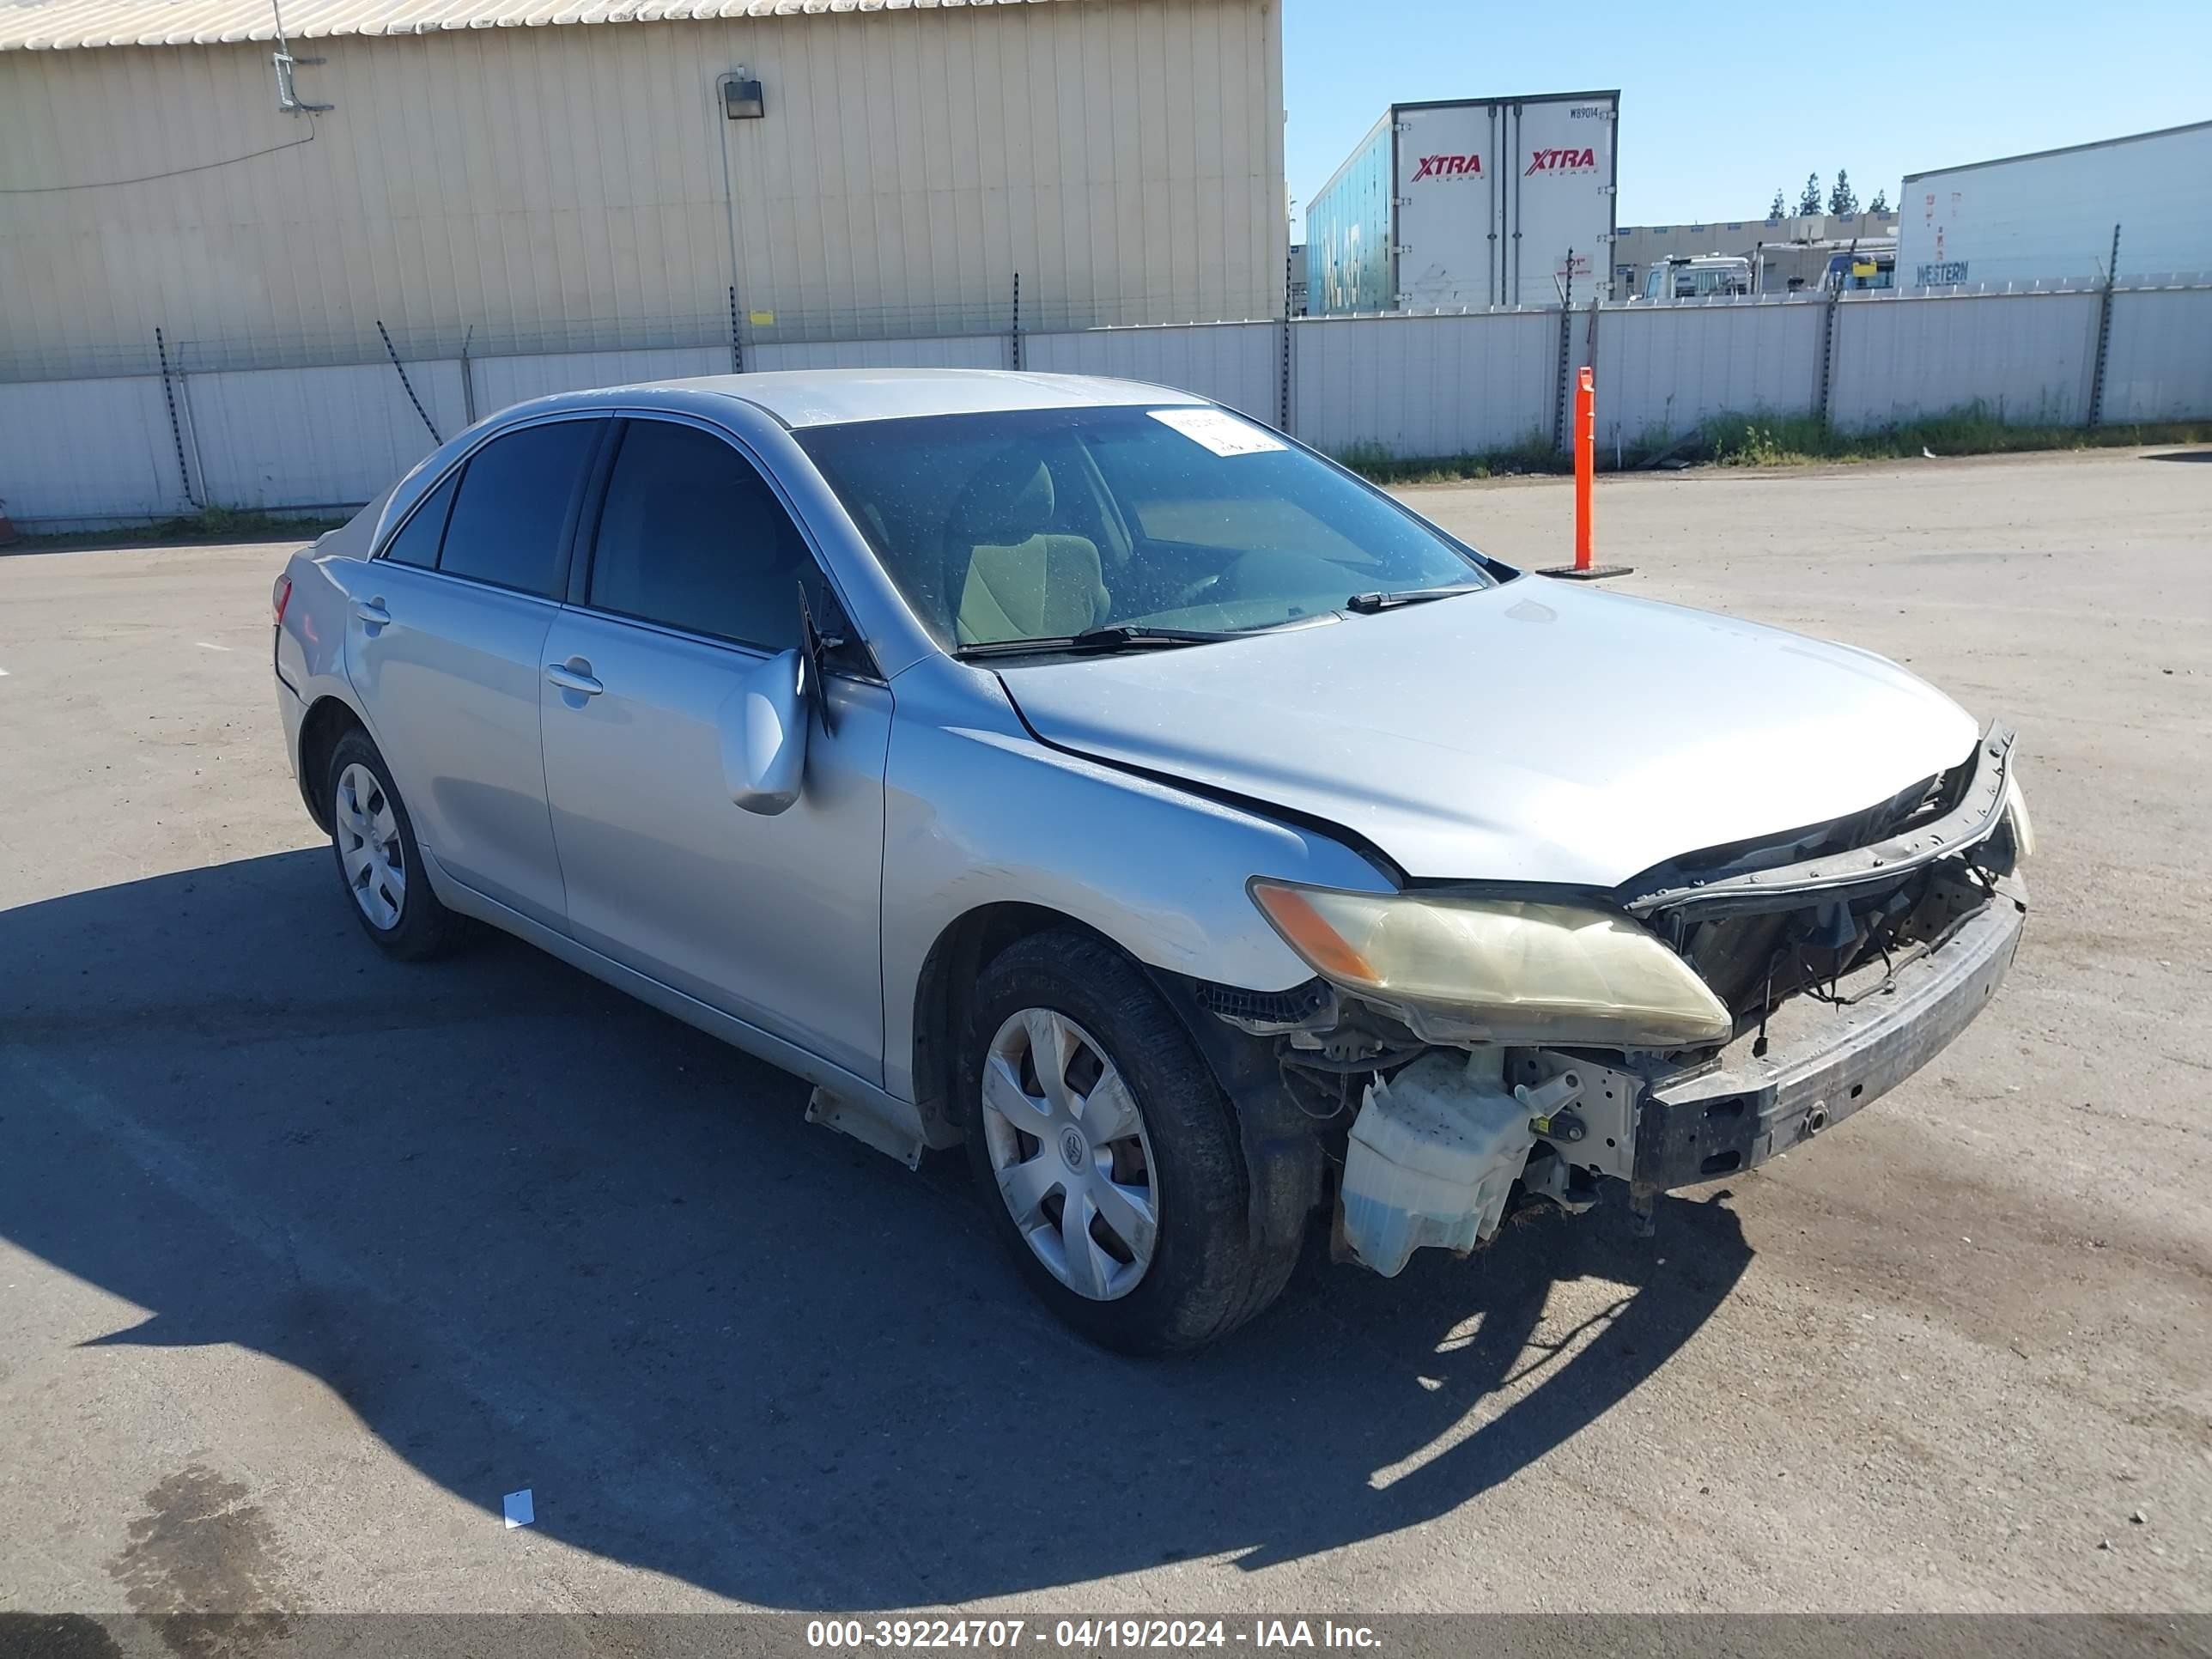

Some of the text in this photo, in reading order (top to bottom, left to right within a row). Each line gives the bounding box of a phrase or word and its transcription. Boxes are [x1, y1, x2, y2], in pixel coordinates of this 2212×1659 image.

[1411, 155, 1481, 183] XTRA
[1524, 148, 1595, 177] XTRA
[1917, 261, 1969, 283] WESTERN
